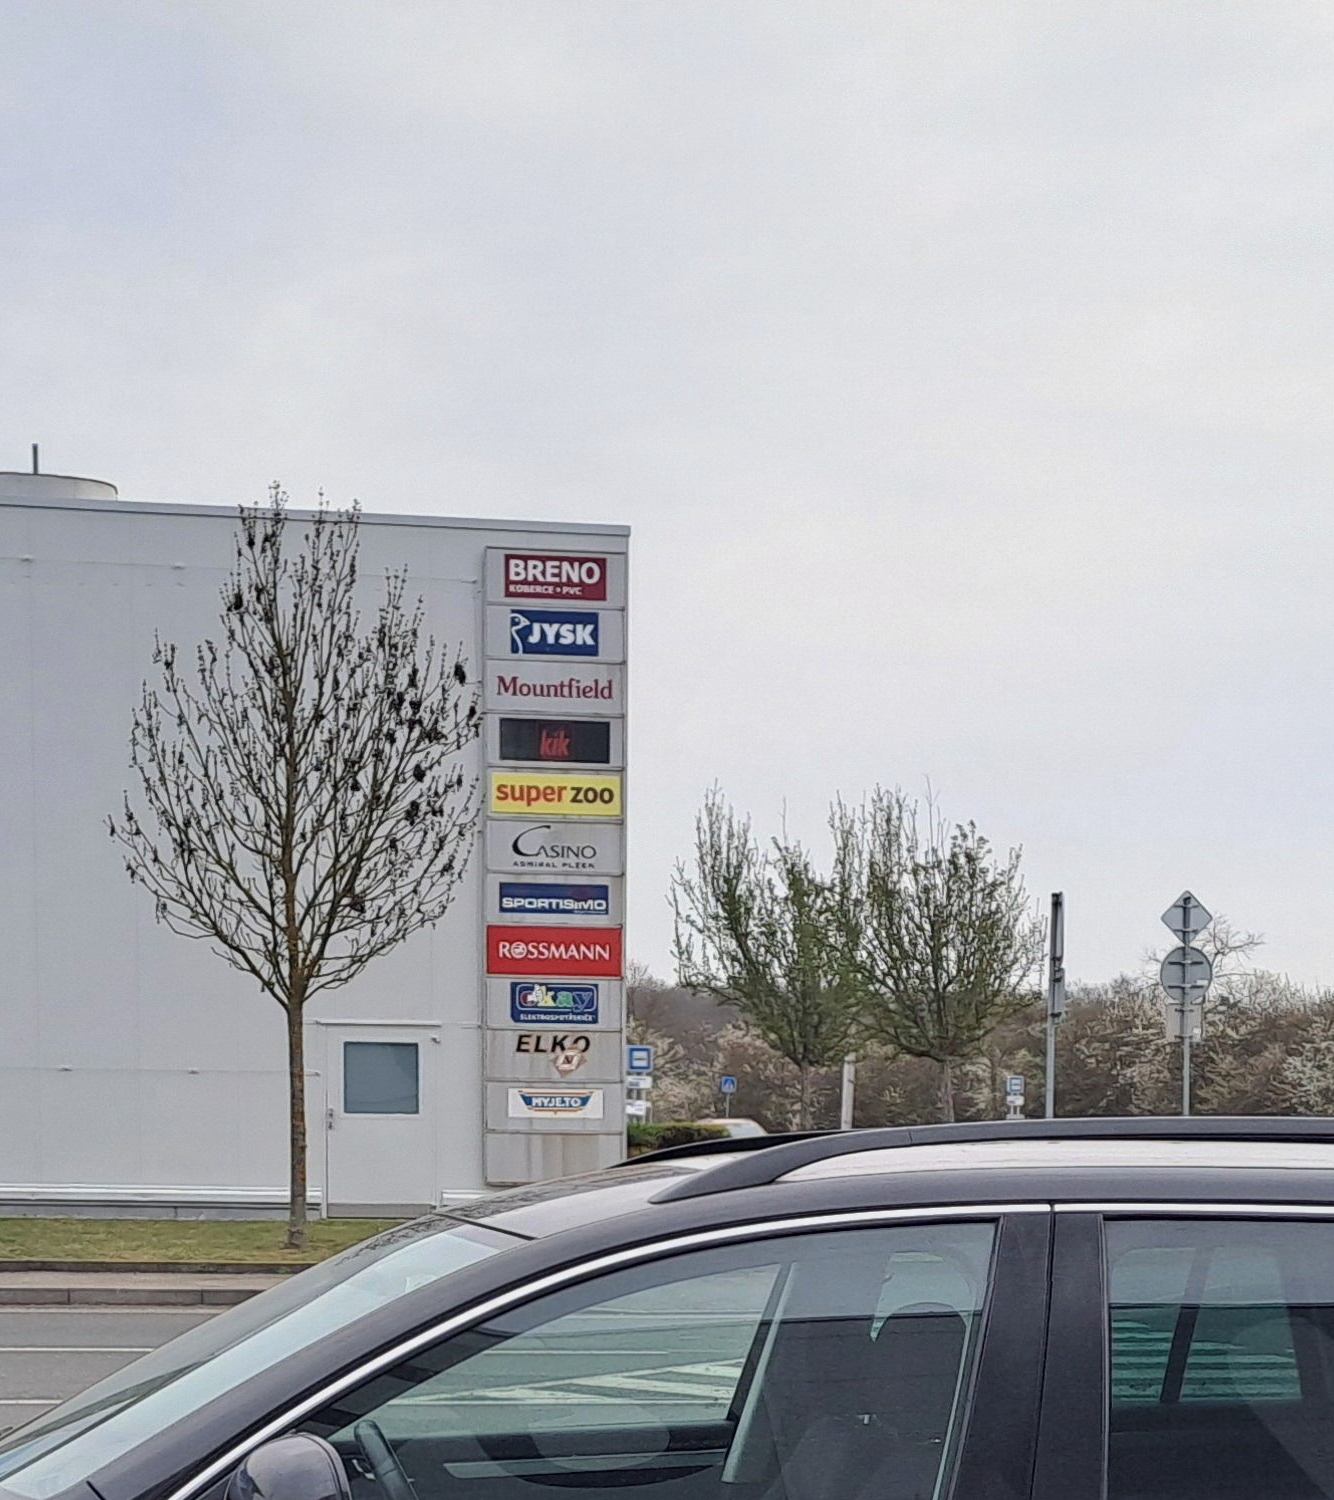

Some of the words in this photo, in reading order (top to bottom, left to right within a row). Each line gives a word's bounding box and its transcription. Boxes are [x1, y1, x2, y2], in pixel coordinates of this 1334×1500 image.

[509, 559, 600, 584] BRENO
[562, 586, 582, 595] PVC
[527, 622, 595, 645] JYSK
[497, 676, 613, 699] Mountfield
[496, 783, 567, 806] super
[570, 787, 614, 804] zoo
[499, 942, 609, 960] ROSSMANN
[516, 1034, 590, 1053] ELKO
